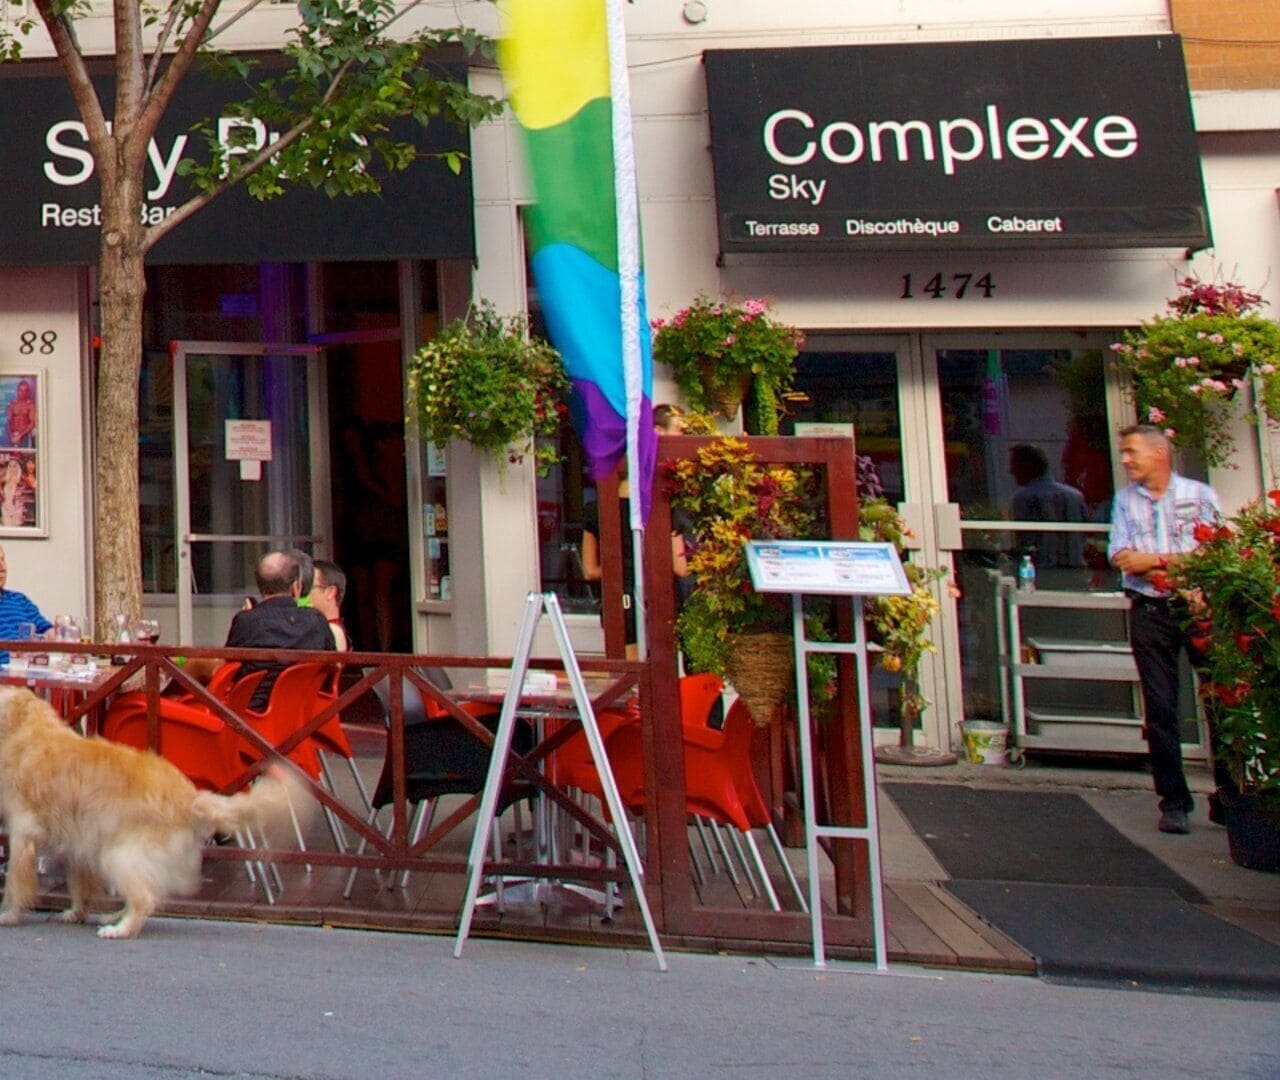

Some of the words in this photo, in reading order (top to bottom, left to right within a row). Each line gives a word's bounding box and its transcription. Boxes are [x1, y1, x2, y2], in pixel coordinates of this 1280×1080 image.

[763, 104, 1139, 174] Complexe
[43, 120, 188, 201] Sy
[768, 173, 827, 206] Sky
[42, 204, 102, 226] Rest
[987, 216, 1062, 233] Cabaret
[746, 221, 820, 236] Terrasse
[845, 219, 960, 236] Discothèque
[900, 272, 997, 300] 1474
[19, 330, 57, 354] 88
